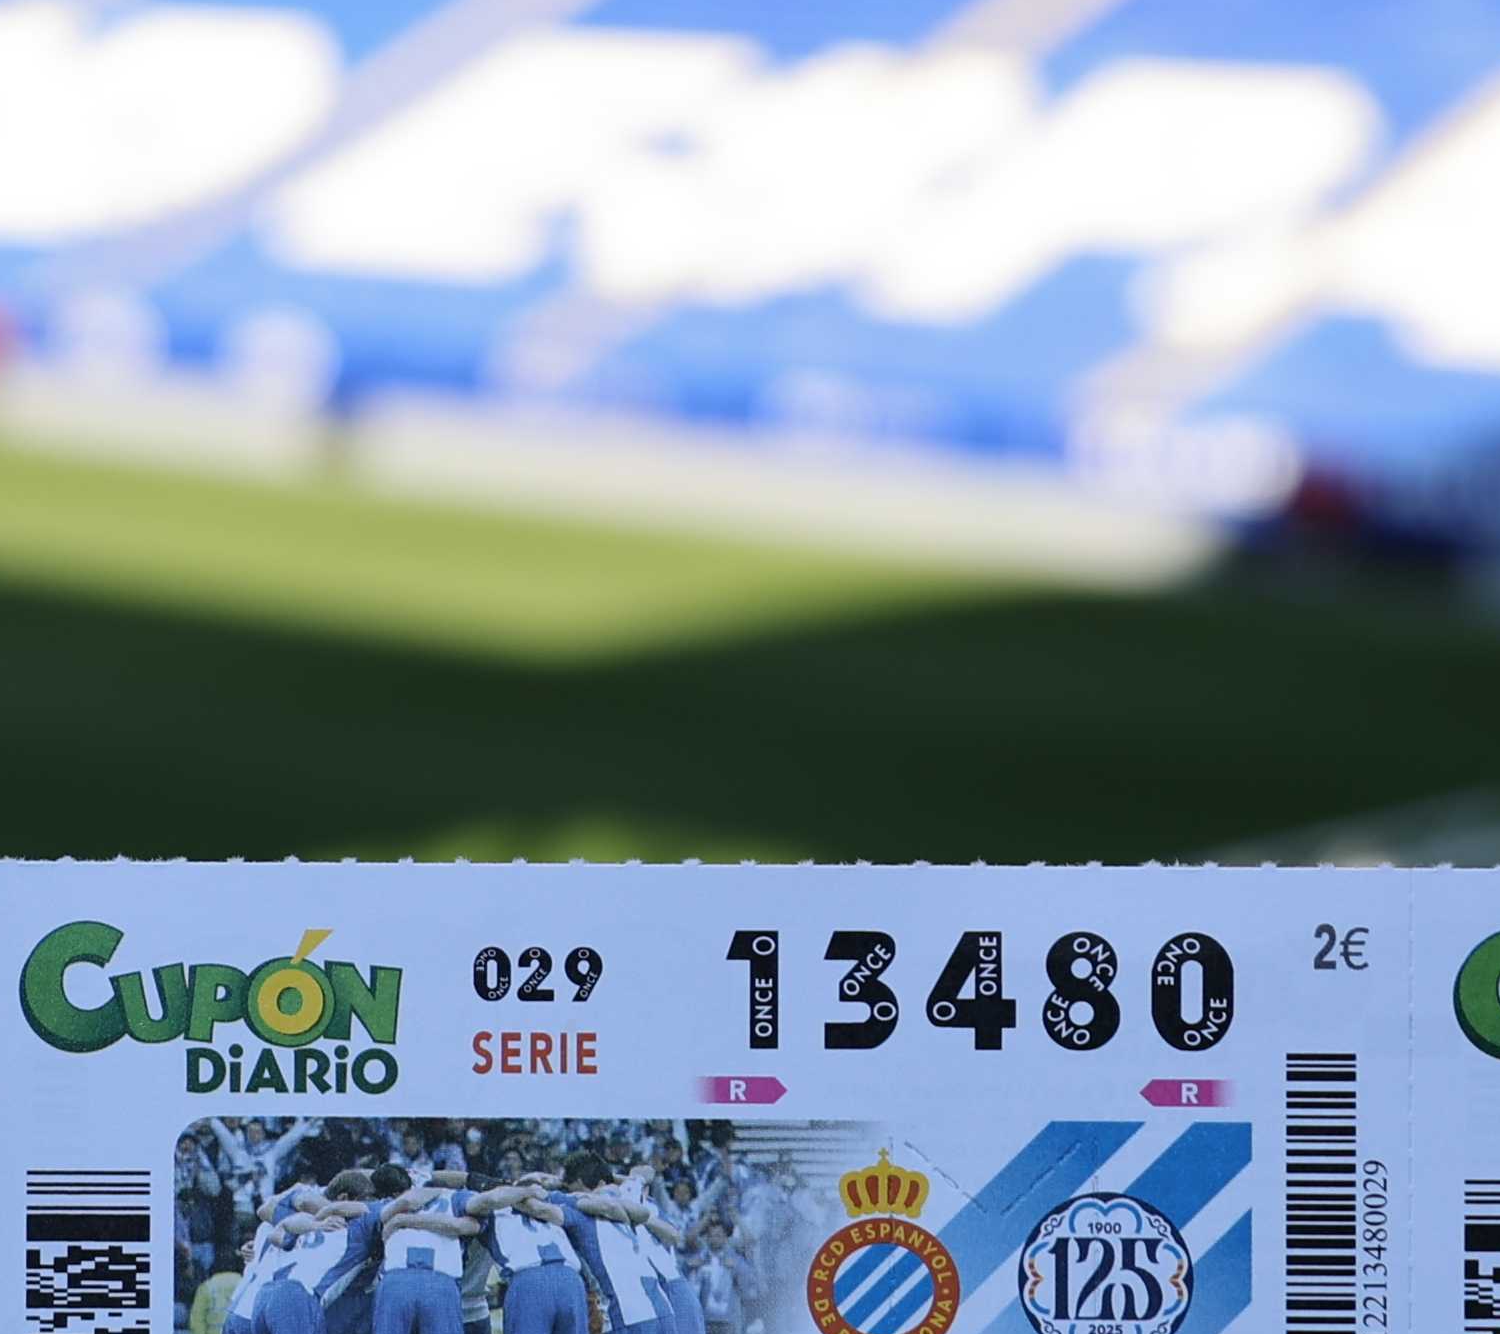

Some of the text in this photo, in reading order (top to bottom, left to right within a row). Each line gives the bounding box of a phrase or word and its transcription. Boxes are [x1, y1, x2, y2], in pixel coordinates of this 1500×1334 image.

[1313, 923, 1370, 971] 2€
[473, 946, 603, 1002] 029
[725, 930, 1235, 1052] 13480
[472, 1030, 600, 1076] SERIE
